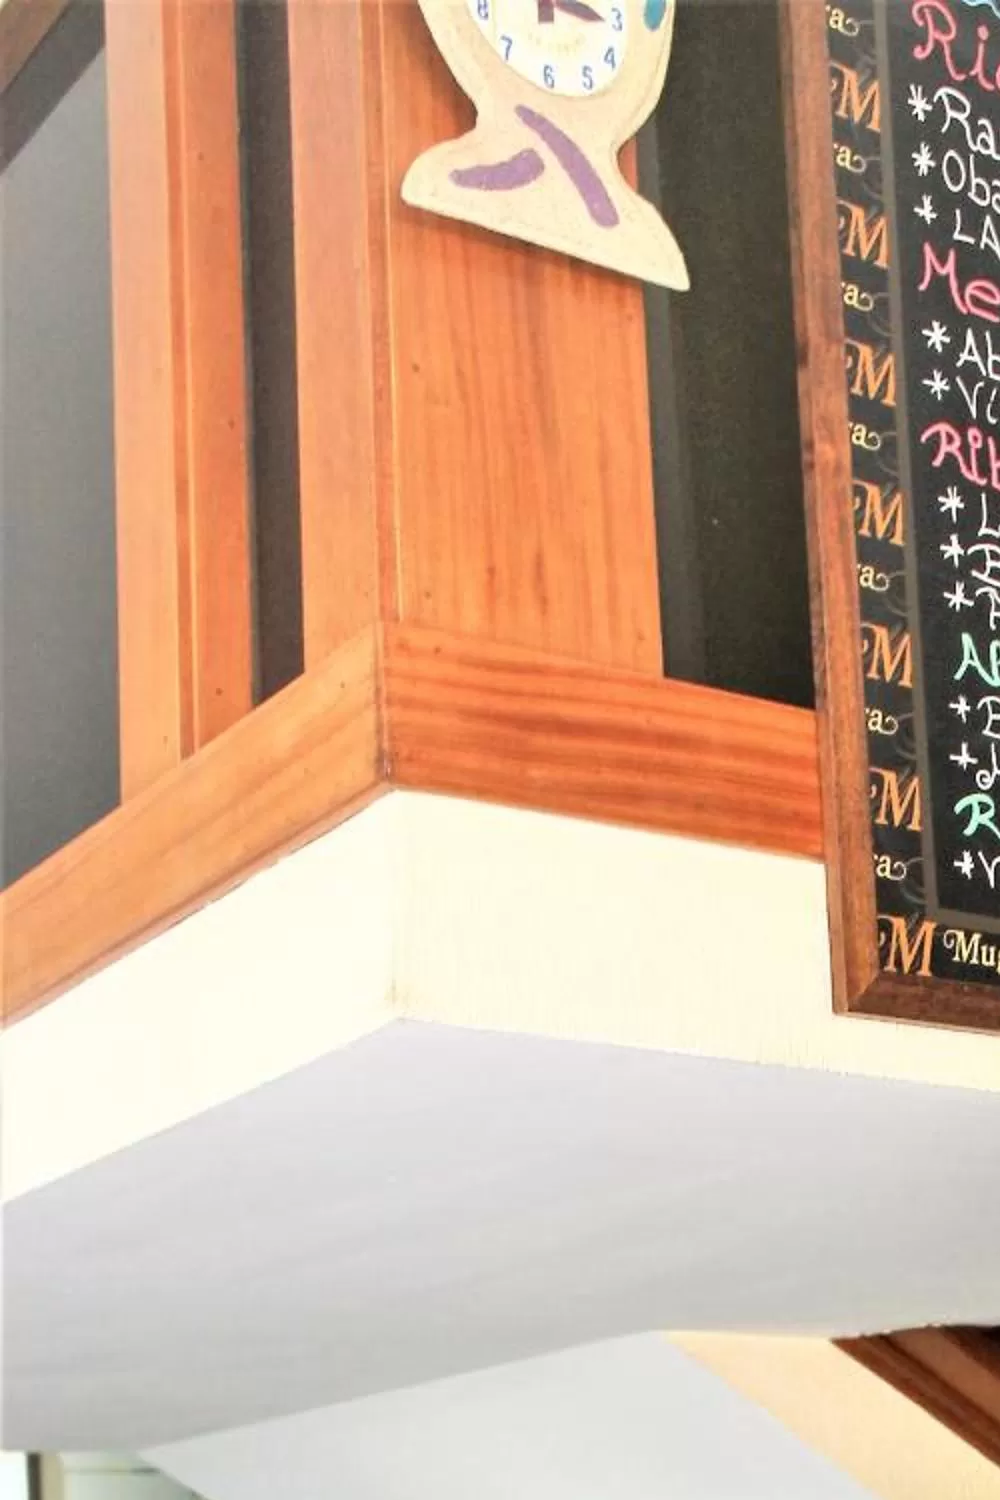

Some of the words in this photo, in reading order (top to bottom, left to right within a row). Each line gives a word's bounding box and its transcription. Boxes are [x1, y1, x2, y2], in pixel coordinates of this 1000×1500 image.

[500, 35, 513, 61] 7
[611, 8, 623, 31] 3
[543, 64, 555, 89] 6
[582, 65, 594, 90] 5
[604, 46, 616, 71] 4
[832, 61, 881, 132] M
[839, 200, 889, 268] M
[846, 339, 896, 407] M
[855, 480, 905, 546] M
[864, 623, 913, 688] M
[870, 767, 922, 831] M
[879, 915, 937, 977] M
